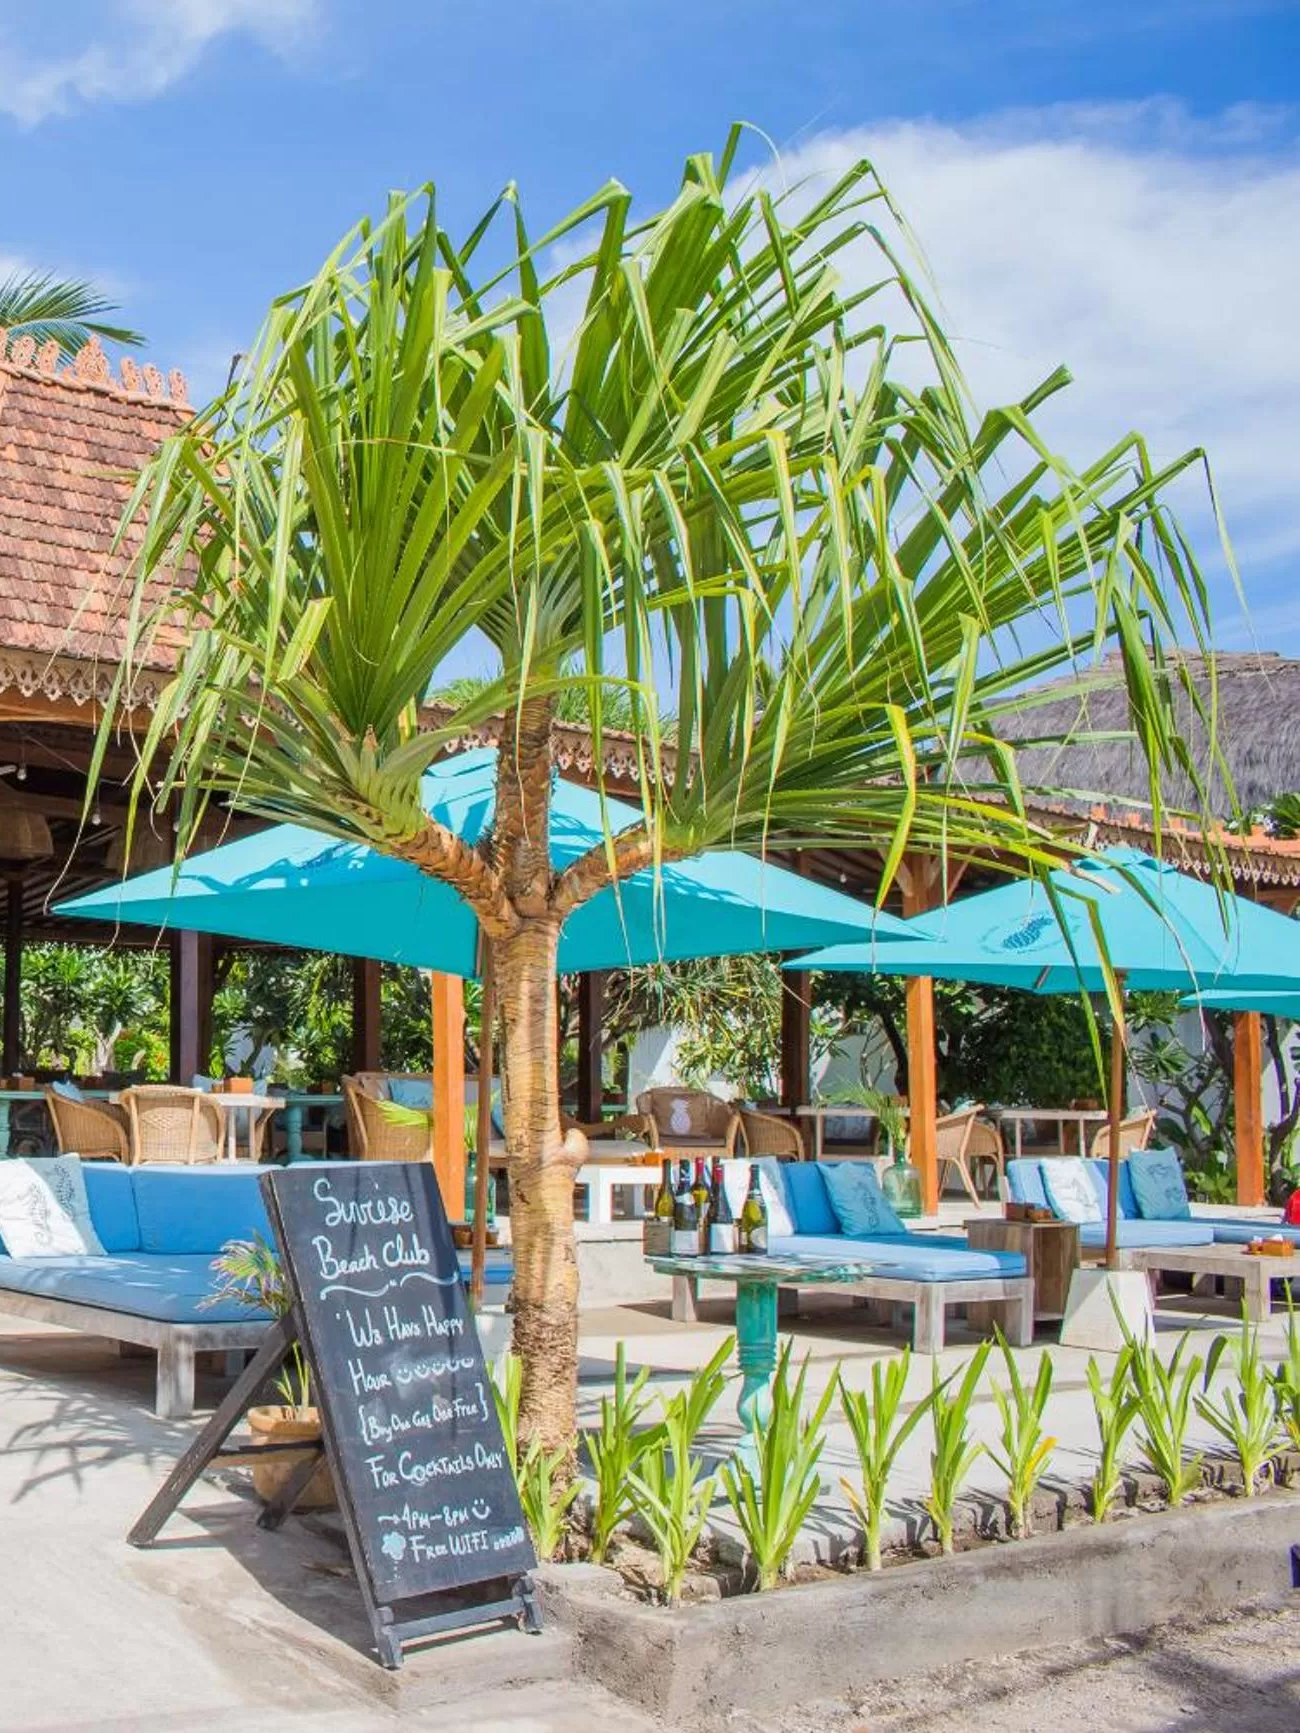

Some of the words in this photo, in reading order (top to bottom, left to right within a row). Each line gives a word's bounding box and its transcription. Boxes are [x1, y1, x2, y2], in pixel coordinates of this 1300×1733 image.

[312, 1177, 413, 1227] Sunrise
[312, 1235, 380, 1280] Beach
[382, 1232, 431, 1268] Club
